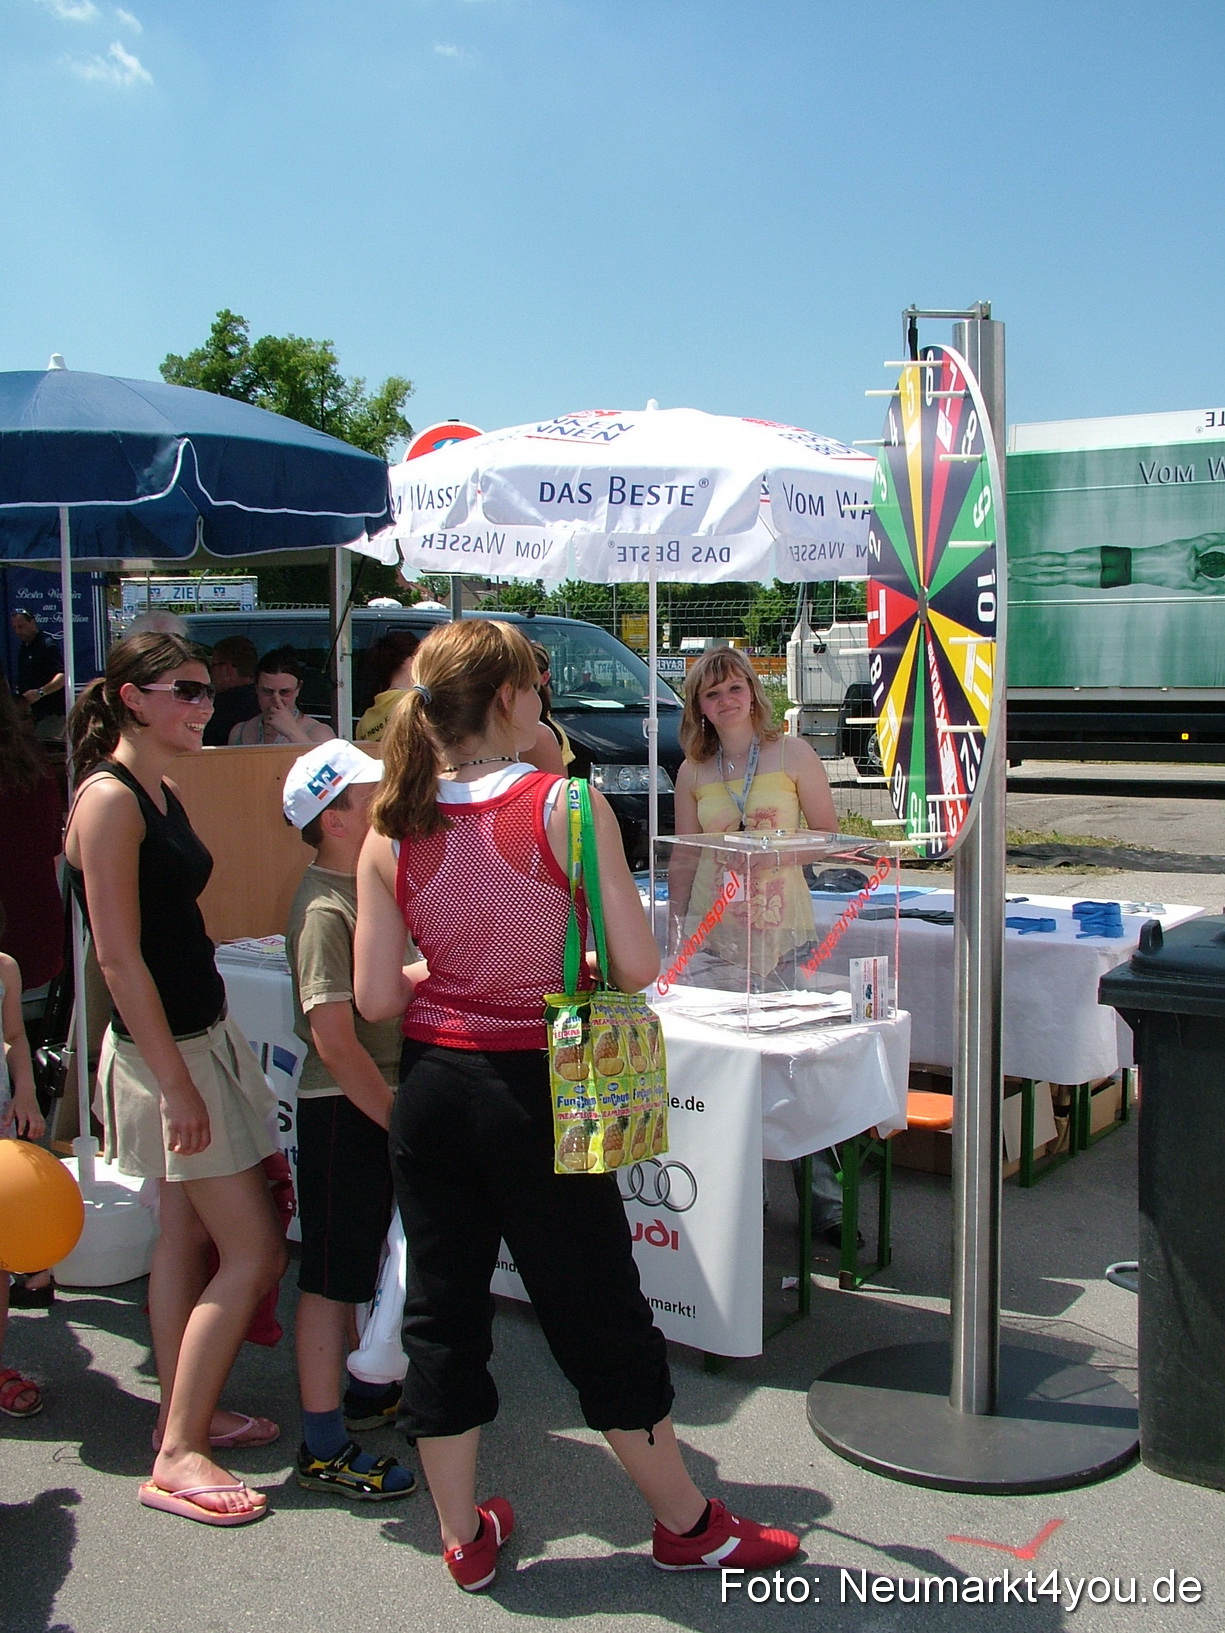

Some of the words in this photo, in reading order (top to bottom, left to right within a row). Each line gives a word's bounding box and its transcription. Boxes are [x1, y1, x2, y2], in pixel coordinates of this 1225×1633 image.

[889, 408, 899, 447] 4
[962, 409, 977, 463] 8
[540, 481, 592, 505] DAS
[876, 463, 887, 501] 3
[973, 485, 991, 528] 9
[868, 530, 881, 562] 2
[656, 870, 741, 996] Gewinnspiel
[667, 1095, 705, 1112] le.de
[631, 1218, 679, 1251] udi
[647, 1296, 696, 1319] markt!
